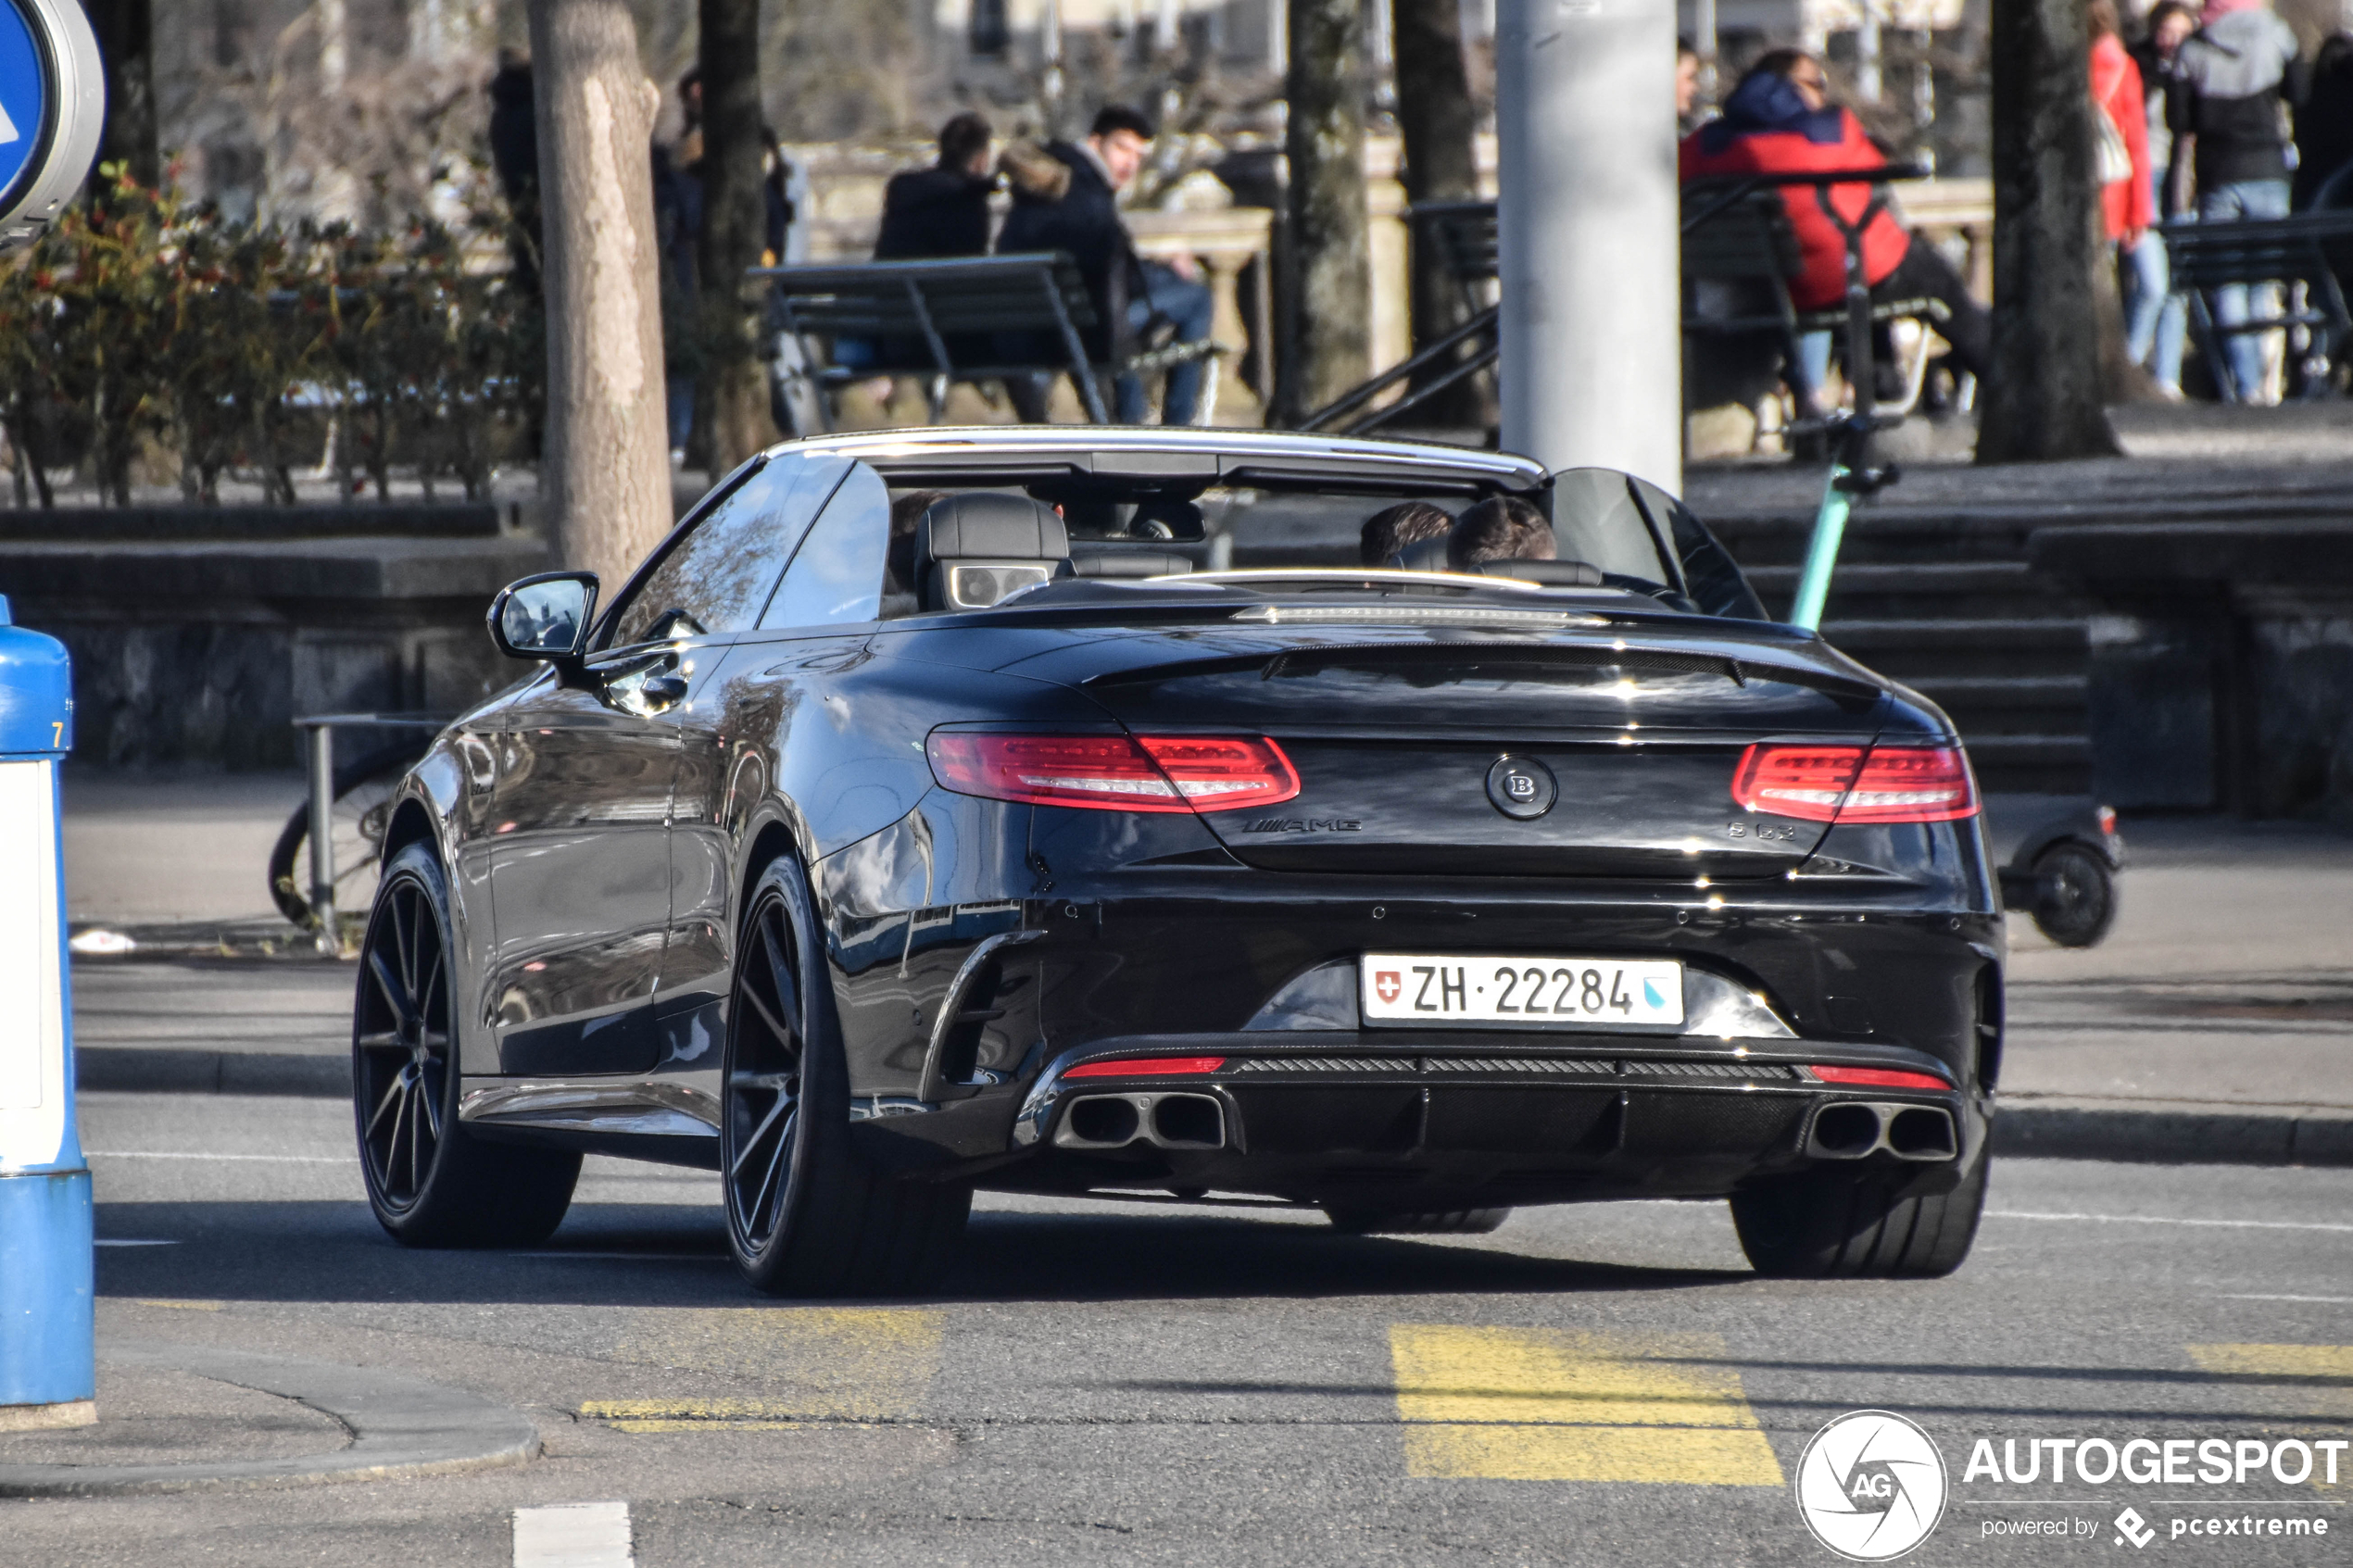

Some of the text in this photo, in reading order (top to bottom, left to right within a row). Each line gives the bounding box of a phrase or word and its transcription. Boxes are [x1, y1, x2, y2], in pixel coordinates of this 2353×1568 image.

[52, 721, 64, 748] 7
[1511, 775, 1535, 796] B
[1728, 822, 1746, 838] S
